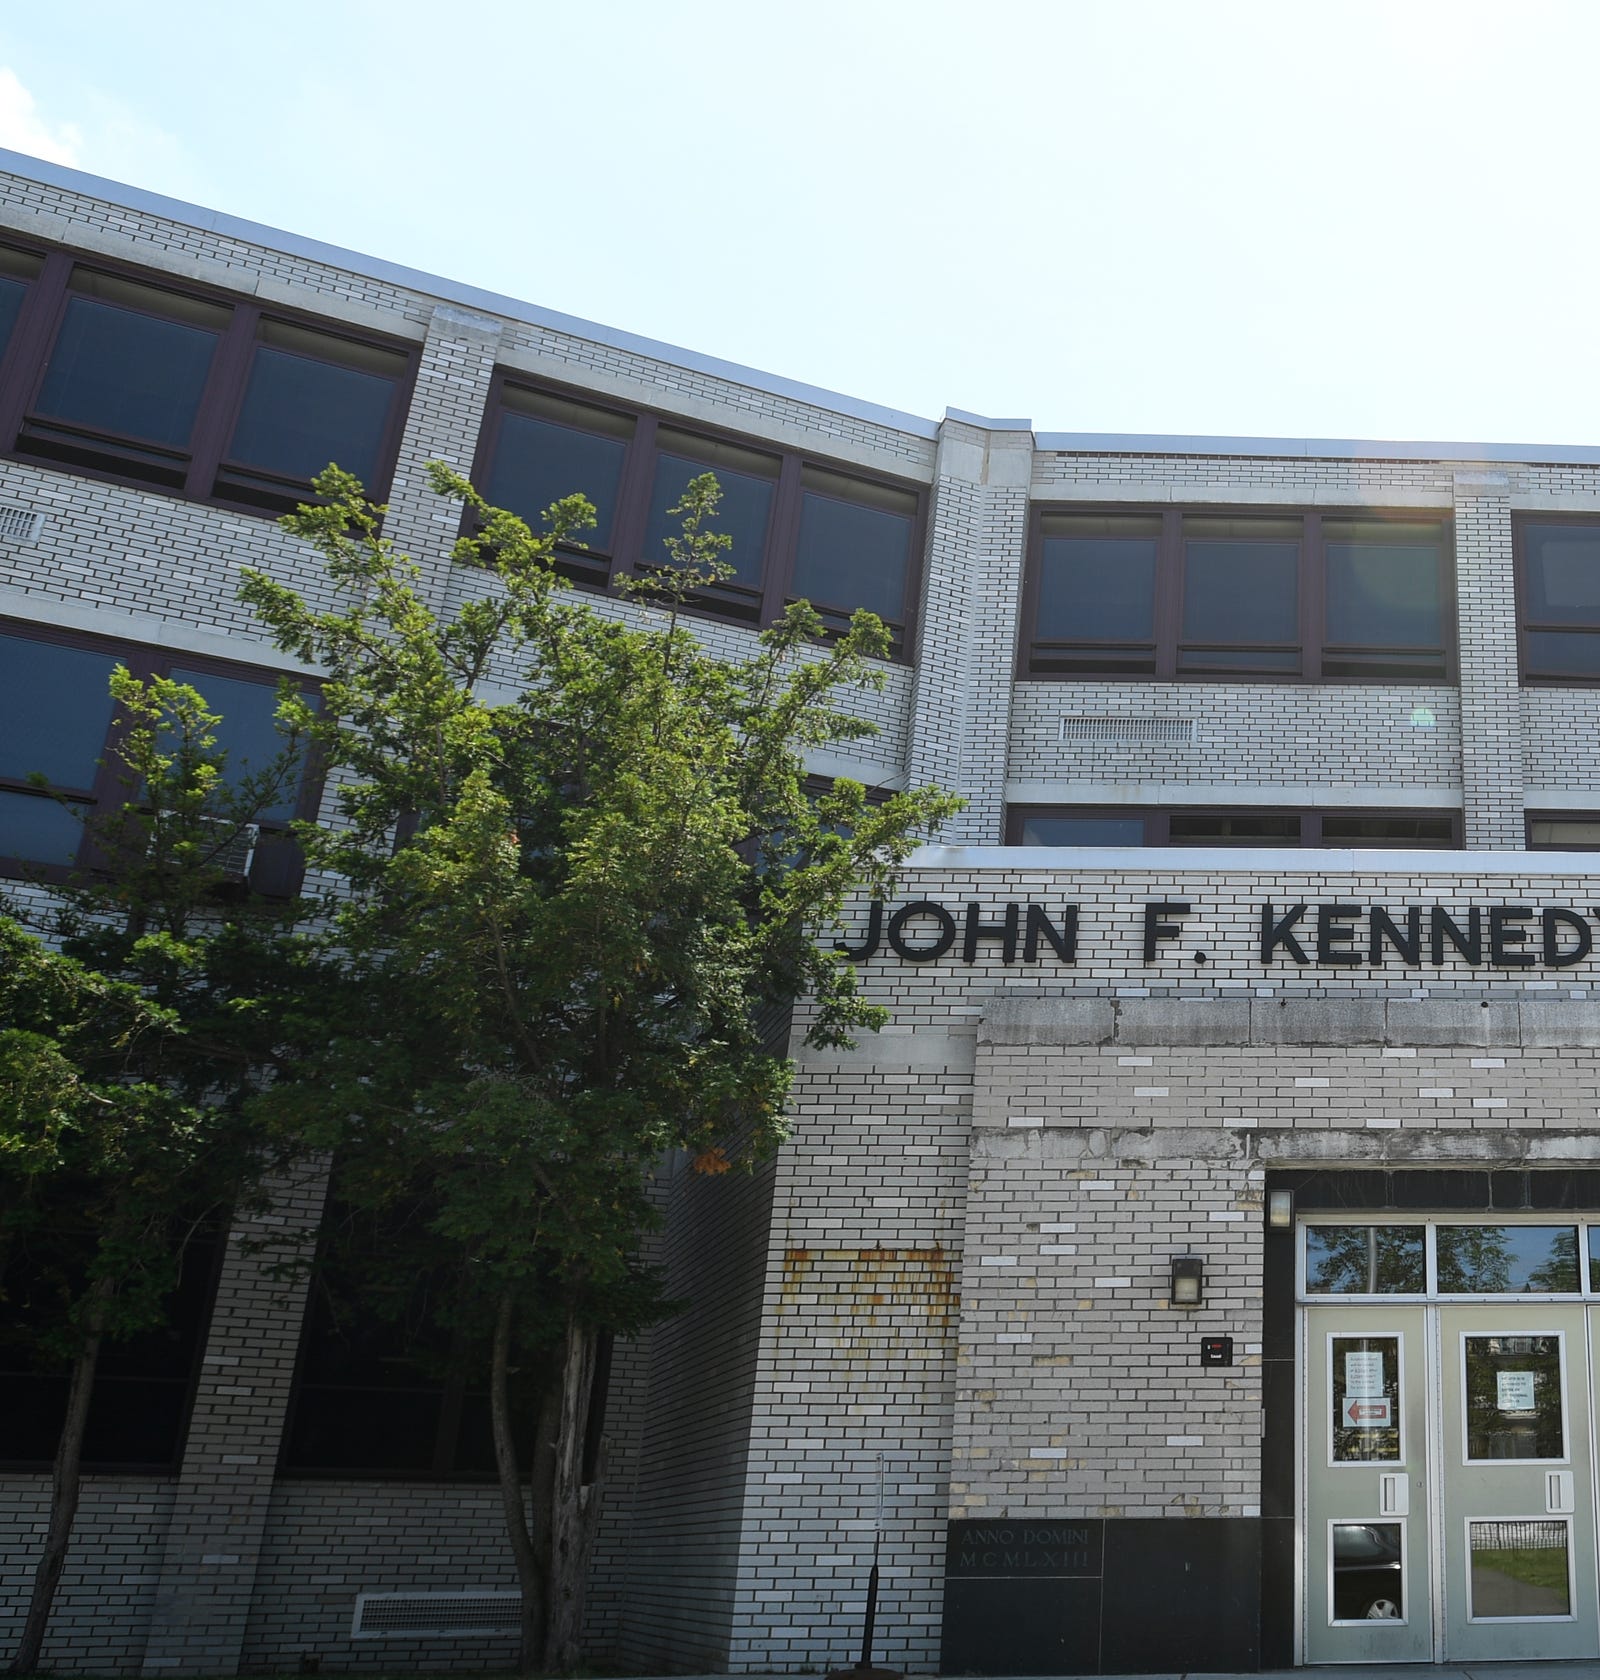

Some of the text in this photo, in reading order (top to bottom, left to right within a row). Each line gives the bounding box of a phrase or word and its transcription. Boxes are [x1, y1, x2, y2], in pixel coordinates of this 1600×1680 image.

[834, 901, 1078, 964] JOHN
[1144, 902, 1207, 964] F.
[960, 1528, 1089, 1545] ANNO DOMINI
